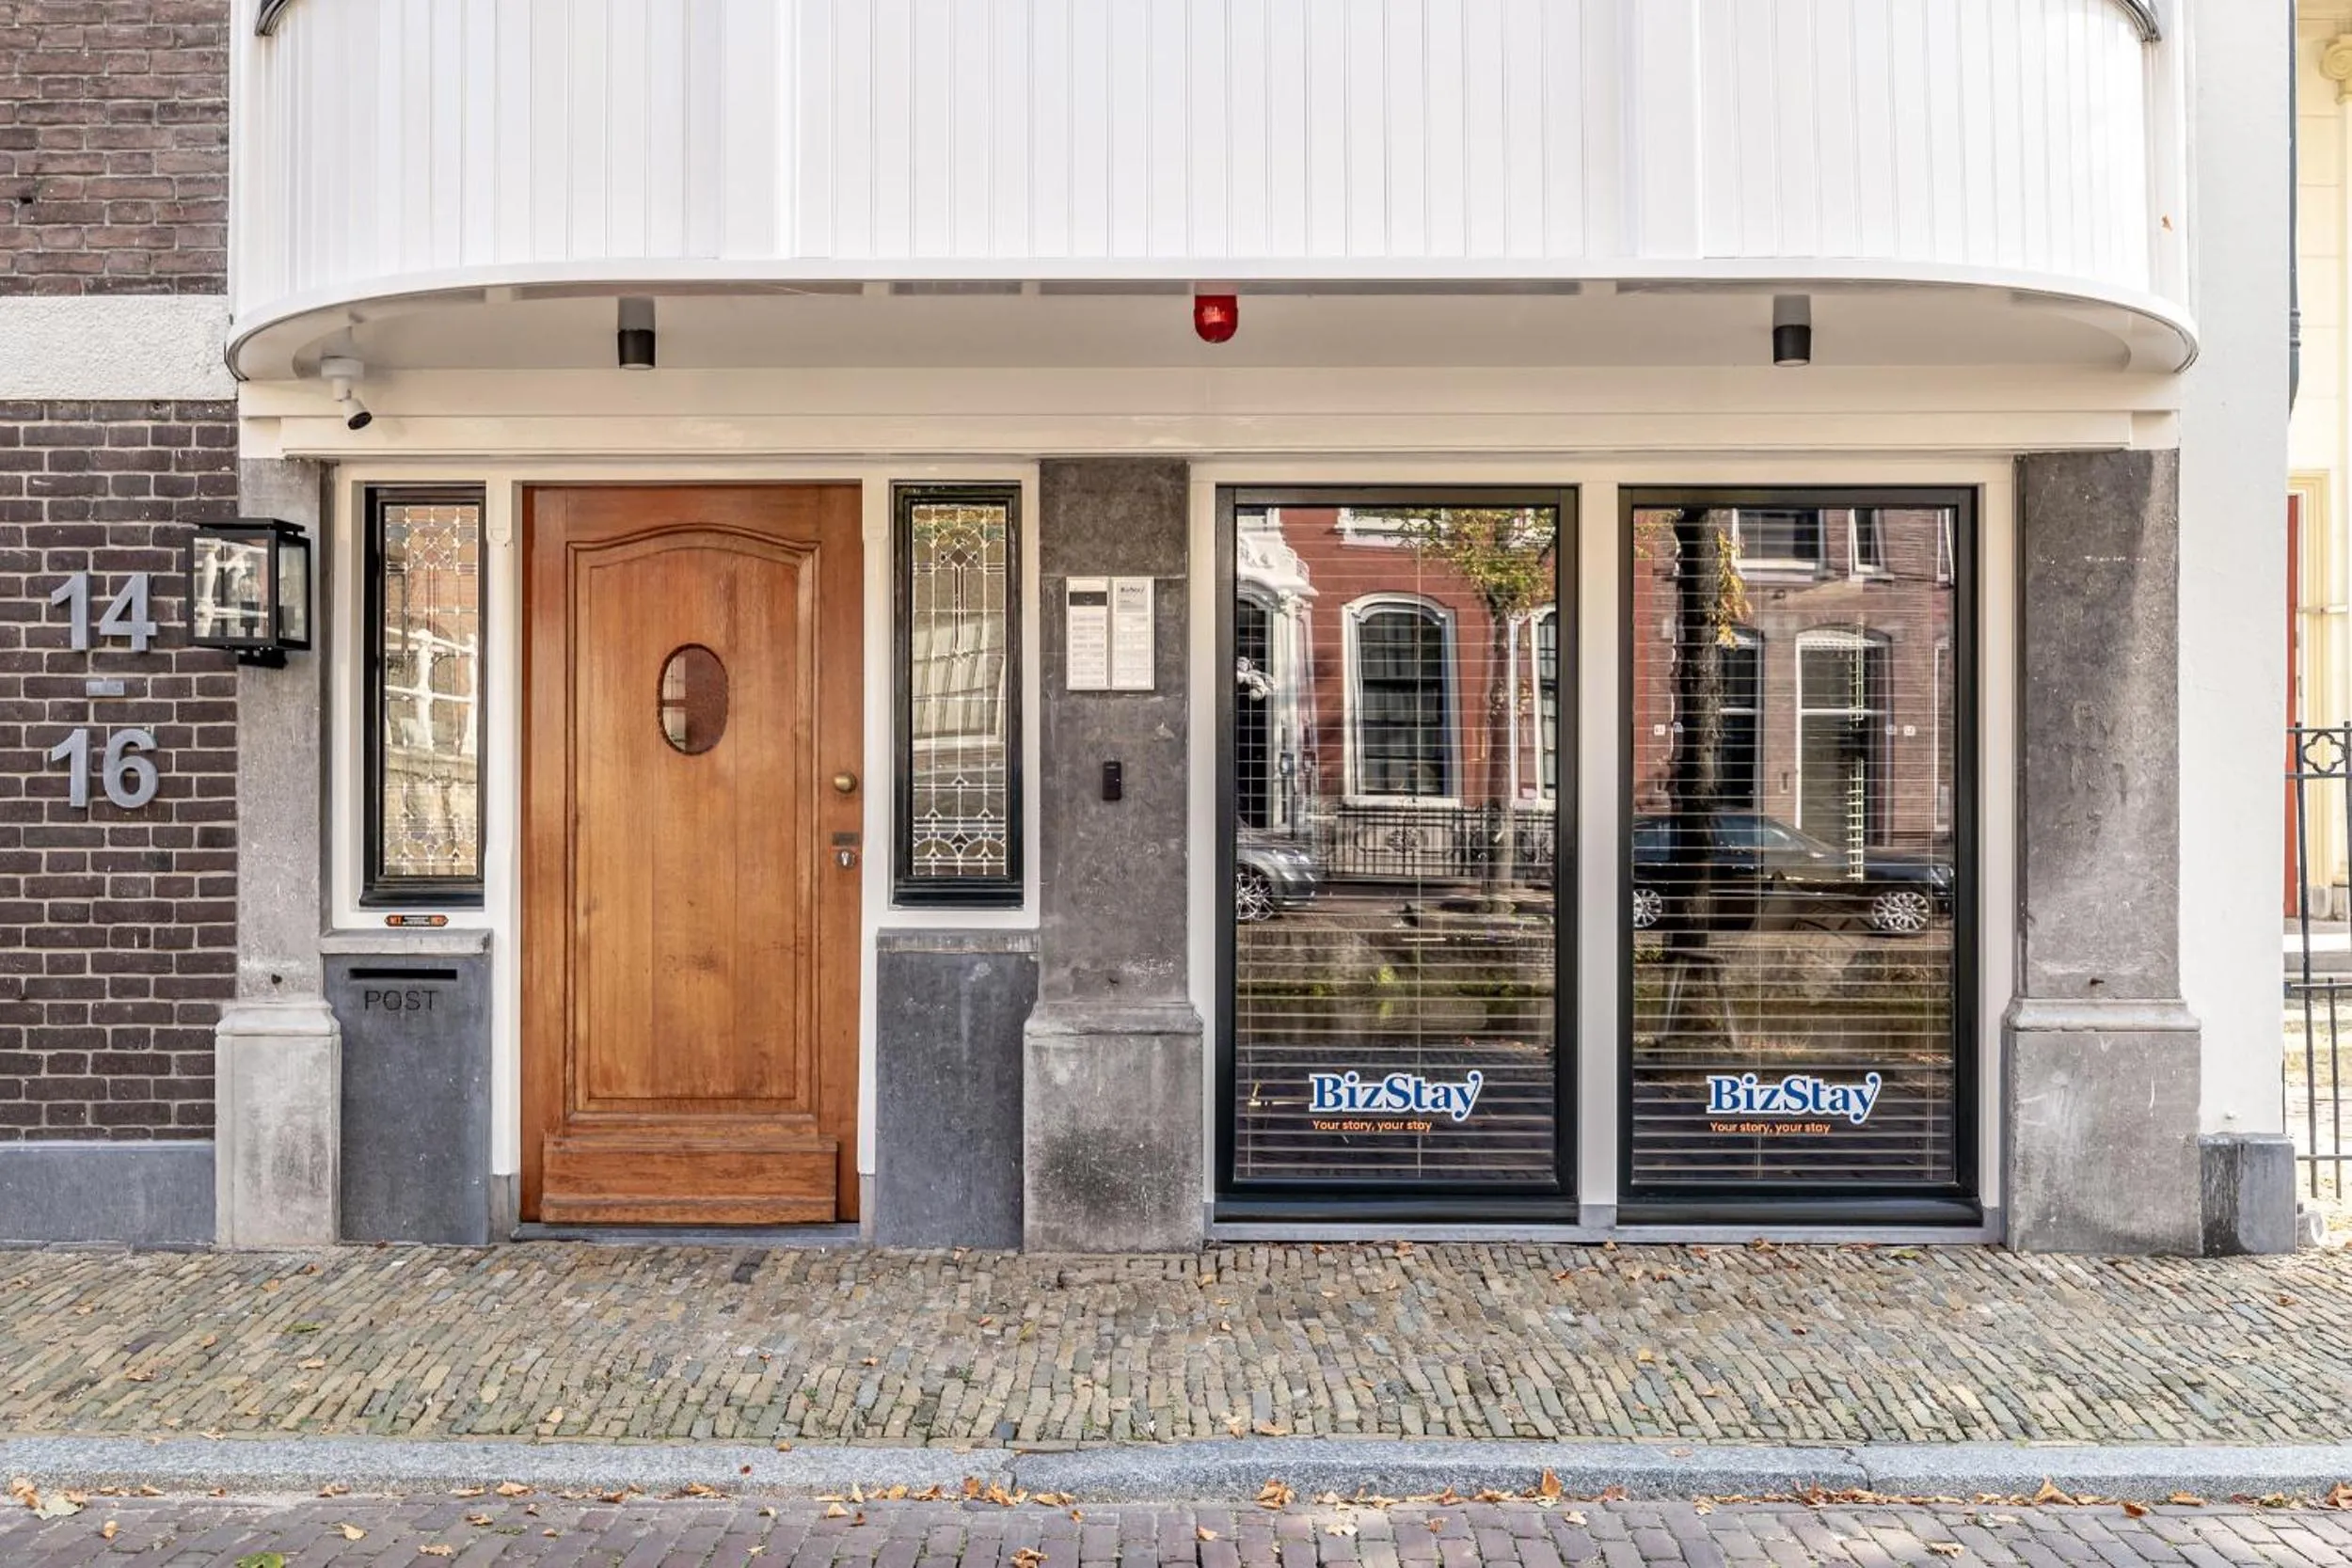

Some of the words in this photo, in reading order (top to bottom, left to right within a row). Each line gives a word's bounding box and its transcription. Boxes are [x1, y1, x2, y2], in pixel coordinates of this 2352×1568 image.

[51, 571, 158, 652] 14
[51, 728, 159, 809] 16
[364, 990, 438, 1011] POST
[1309, 1069, 1484, 1122] BizStay
[1706, 1071, 1882, 1125] BizStay
[1312, 1119, 1340, 1130] Your
[1342, 1119, 1375, 1132] story,
[1377, 1120, 1405, 1132] your
[1406, 1119, 1433, 1133] stay
[1709, 1121, 1738, 1132] Your
[1740, 1121, 1772, 1135] story,
[1775, 1122, 1803, 1135] your
[1804, 1121, 1831, 1135] stay
